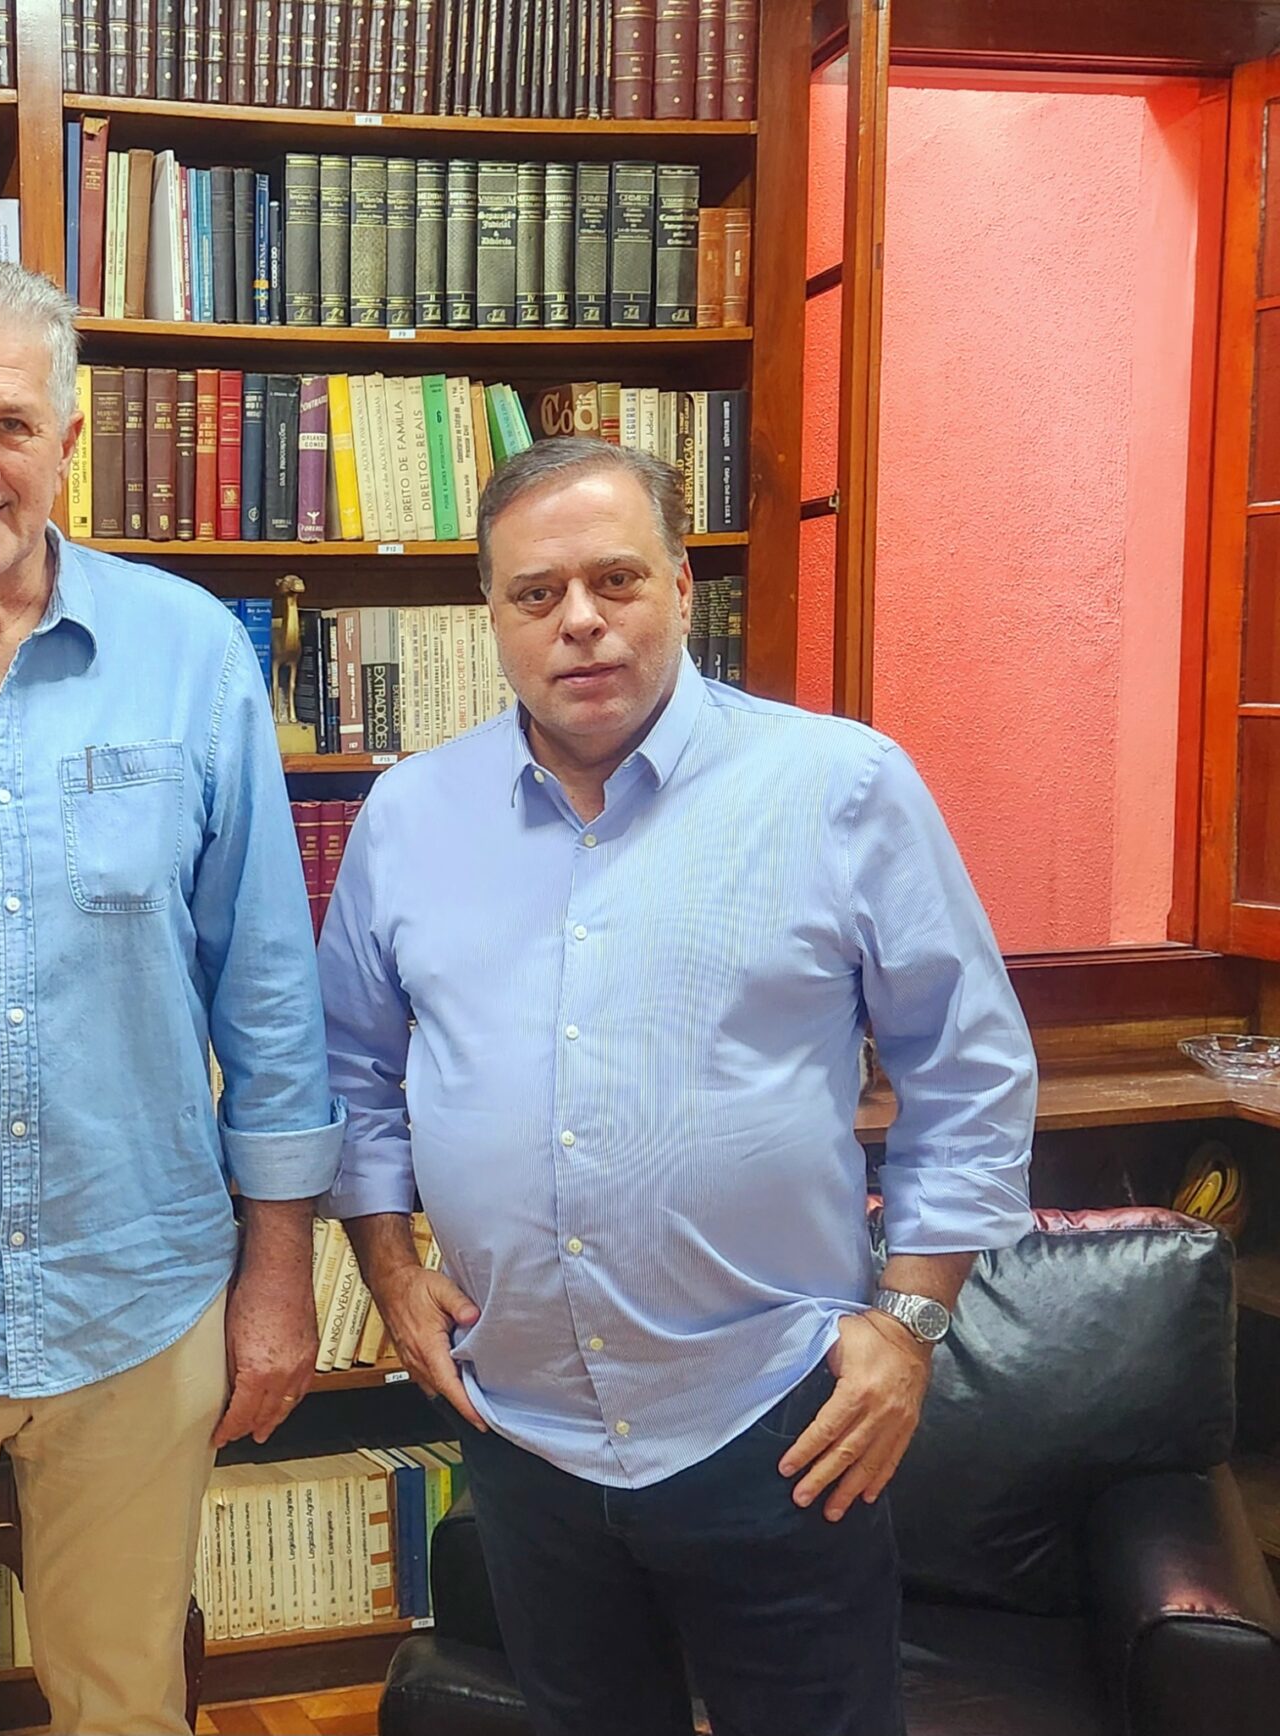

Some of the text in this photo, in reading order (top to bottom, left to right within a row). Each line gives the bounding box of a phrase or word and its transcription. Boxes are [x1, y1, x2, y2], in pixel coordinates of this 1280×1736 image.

[626, 407, 637, 440] SEGURO
[646, 410, 654, 436] Judicial
[72, 458, 81, 504] CURSO DE
[360, 448, 370, 472] AÇÕES
[378, 446, 388, 471] AÇÕES
[392, 400, 414, 522] DIREITO DE FAMÍLIA
[413, 410, 431, 511] DIREITOS REAIS
[683, 438, 695, 504] SEPARAÇÃO
[374, 665, 389, 749] EXTRADIÇÕES
[455, 639, 467, 728] DIREITO SOCIETÁRIO
[327, 1273, 354, 1357] A INSOLVÊNCIA
[286, 1520, 296, 1560] Legislação
[305, 1489, 315, 1559] Legislação Agrária
